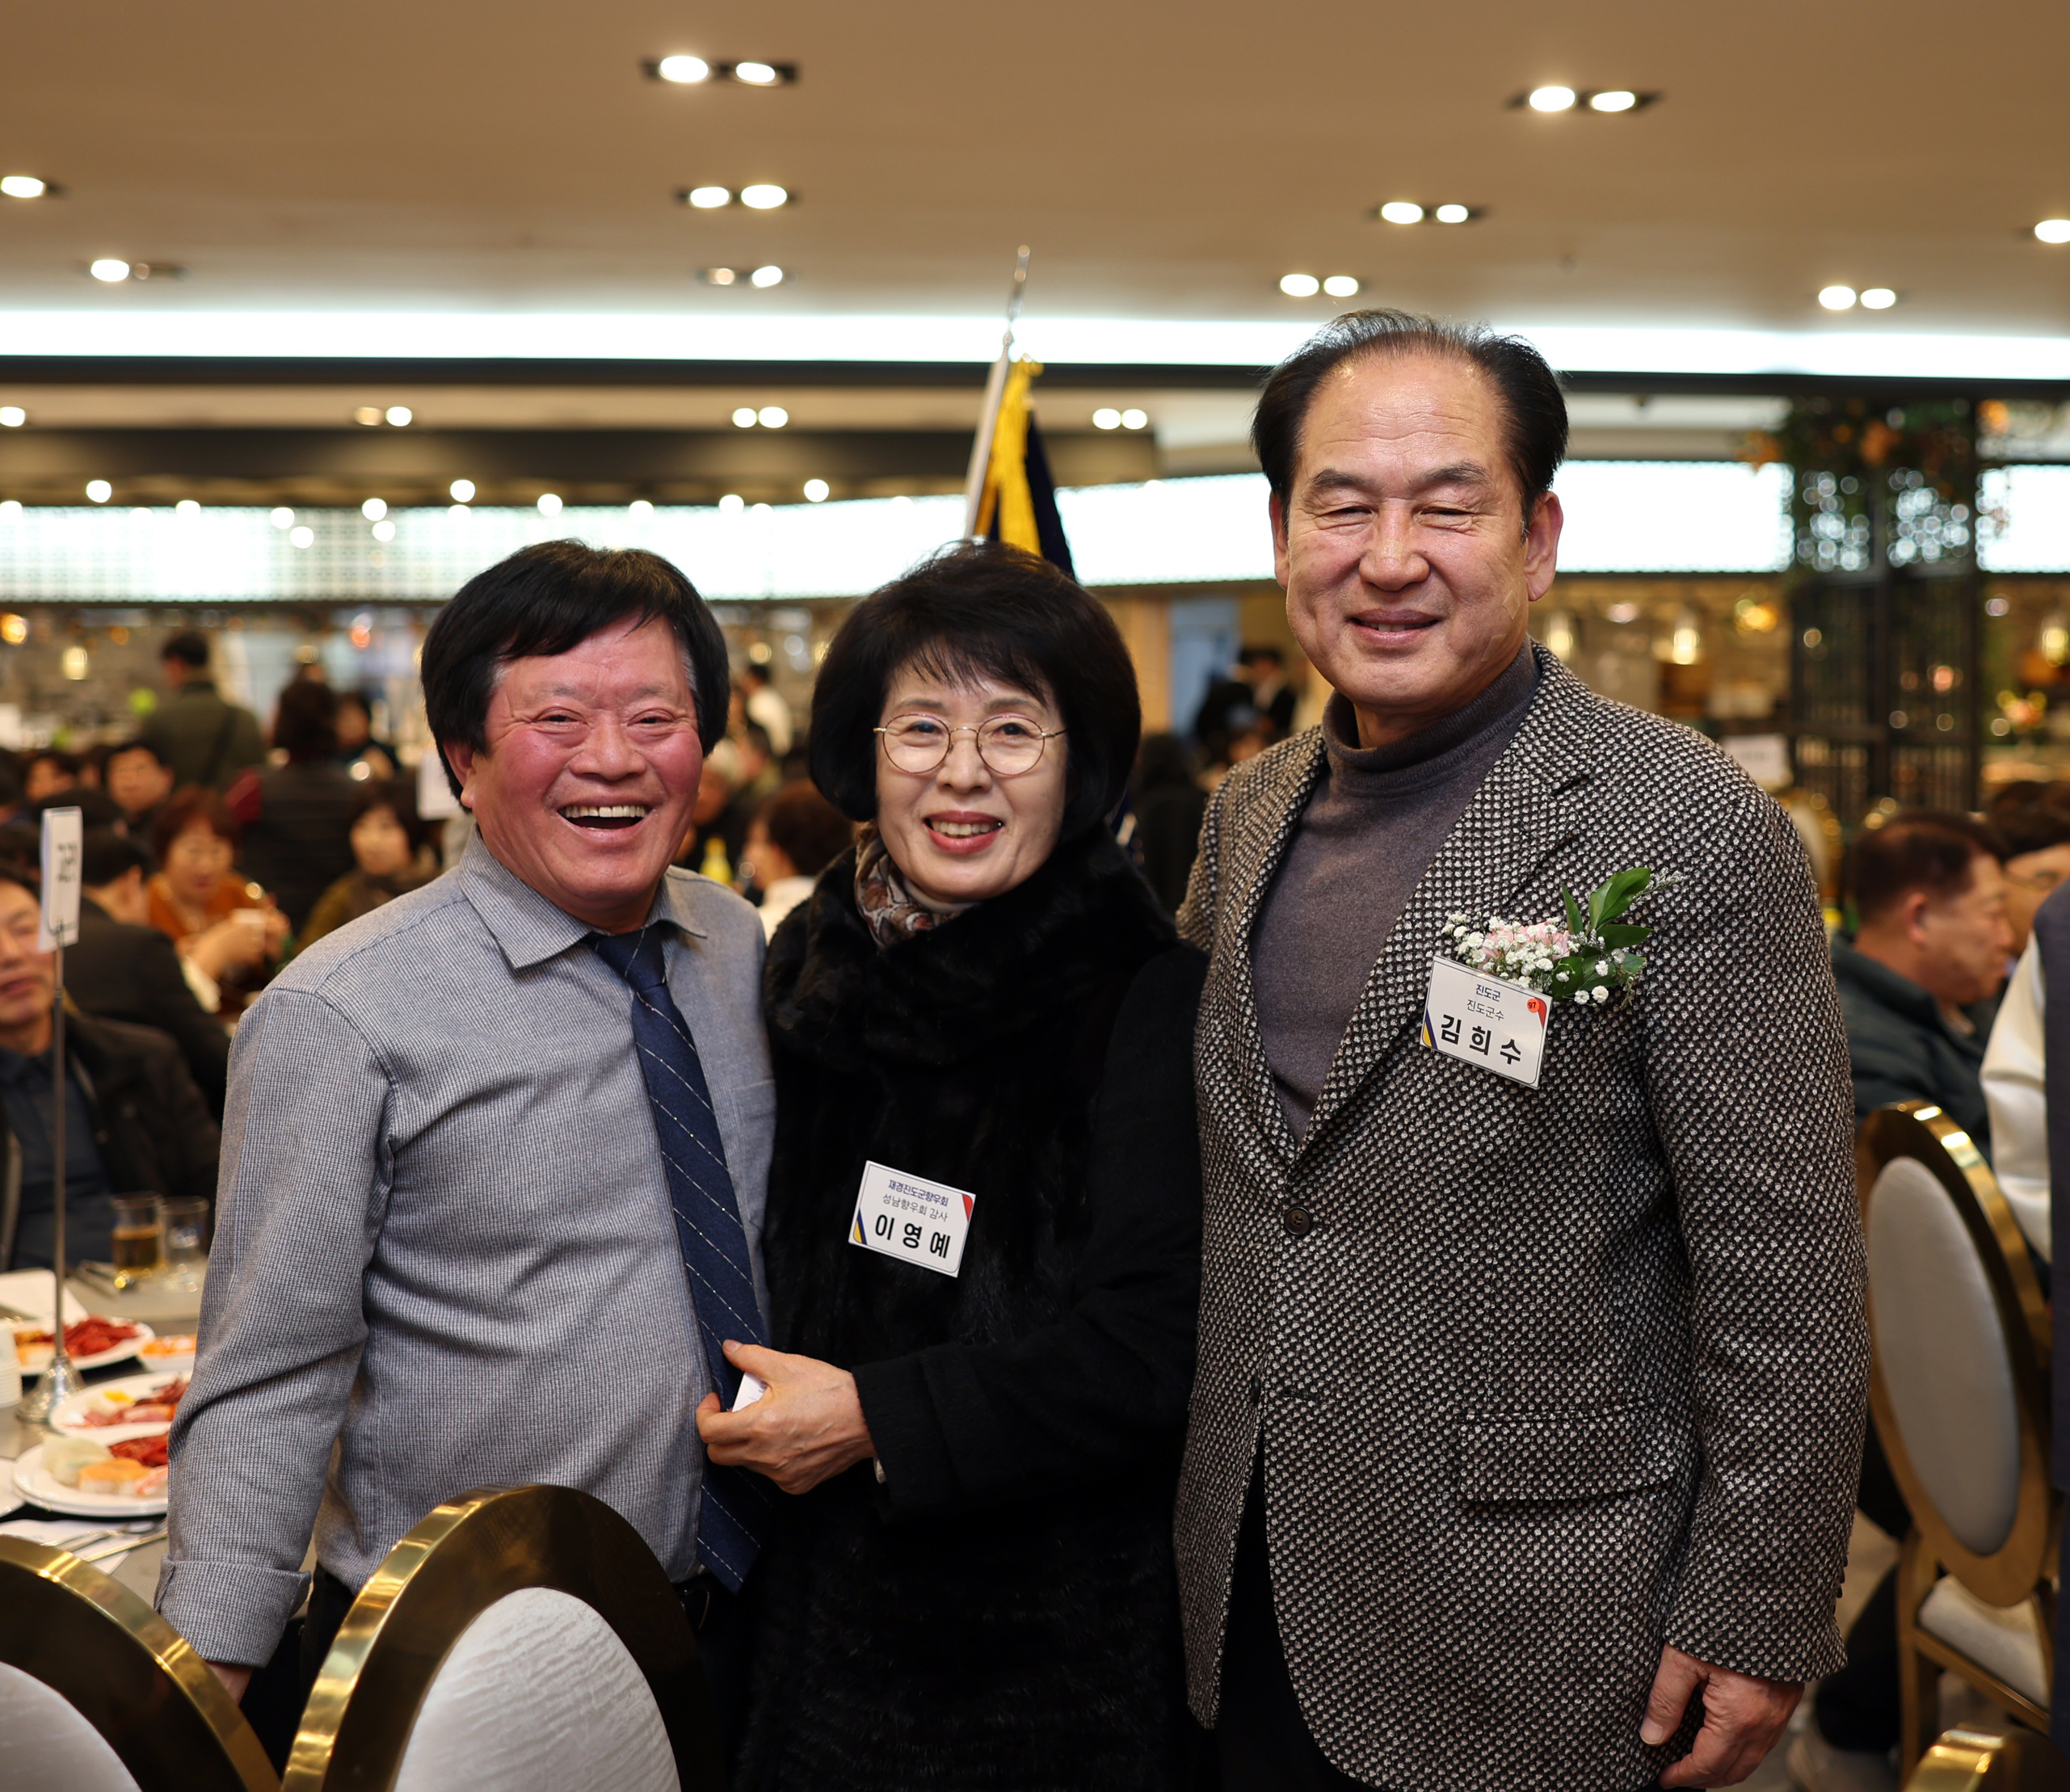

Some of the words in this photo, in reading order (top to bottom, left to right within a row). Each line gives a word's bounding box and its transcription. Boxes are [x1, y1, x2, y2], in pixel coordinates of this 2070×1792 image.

[1475, 984, 1501, 1002] 진도군
[1466, 999, 1504, 1021] 진도군수
[888, 1180, 949, 1207] 재경진도군향우회
[883, 1193, 928, 1216] 성남향우회
[929, 1208, 948, 1222] 감사
